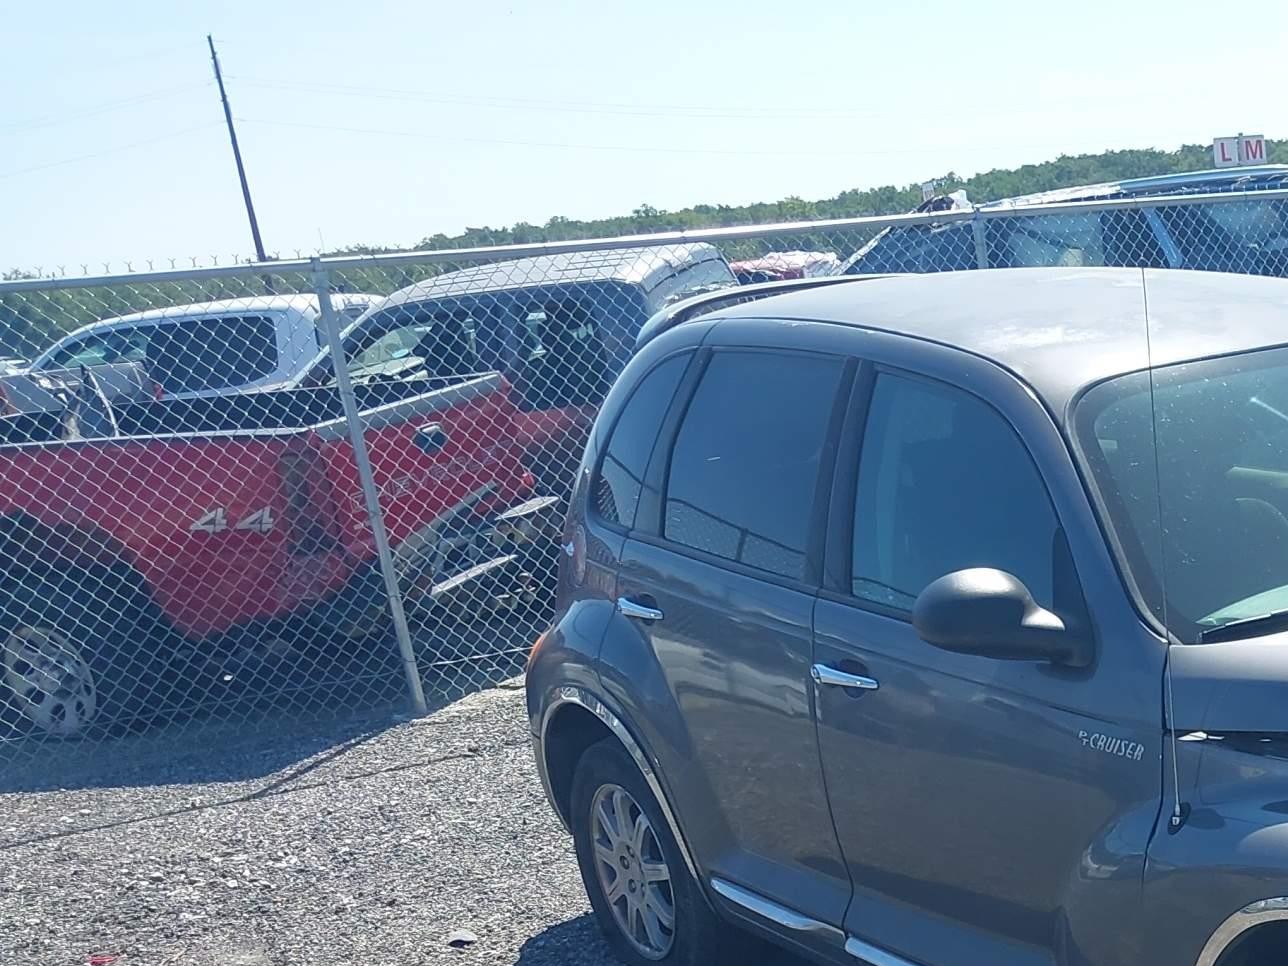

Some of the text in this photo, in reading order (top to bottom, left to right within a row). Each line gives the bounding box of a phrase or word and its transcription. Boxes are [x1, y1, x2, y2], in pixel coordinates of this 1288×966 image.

[1219, 139, 1263, 163] L M
[1088, 732, 1145, 762] CRUISER
